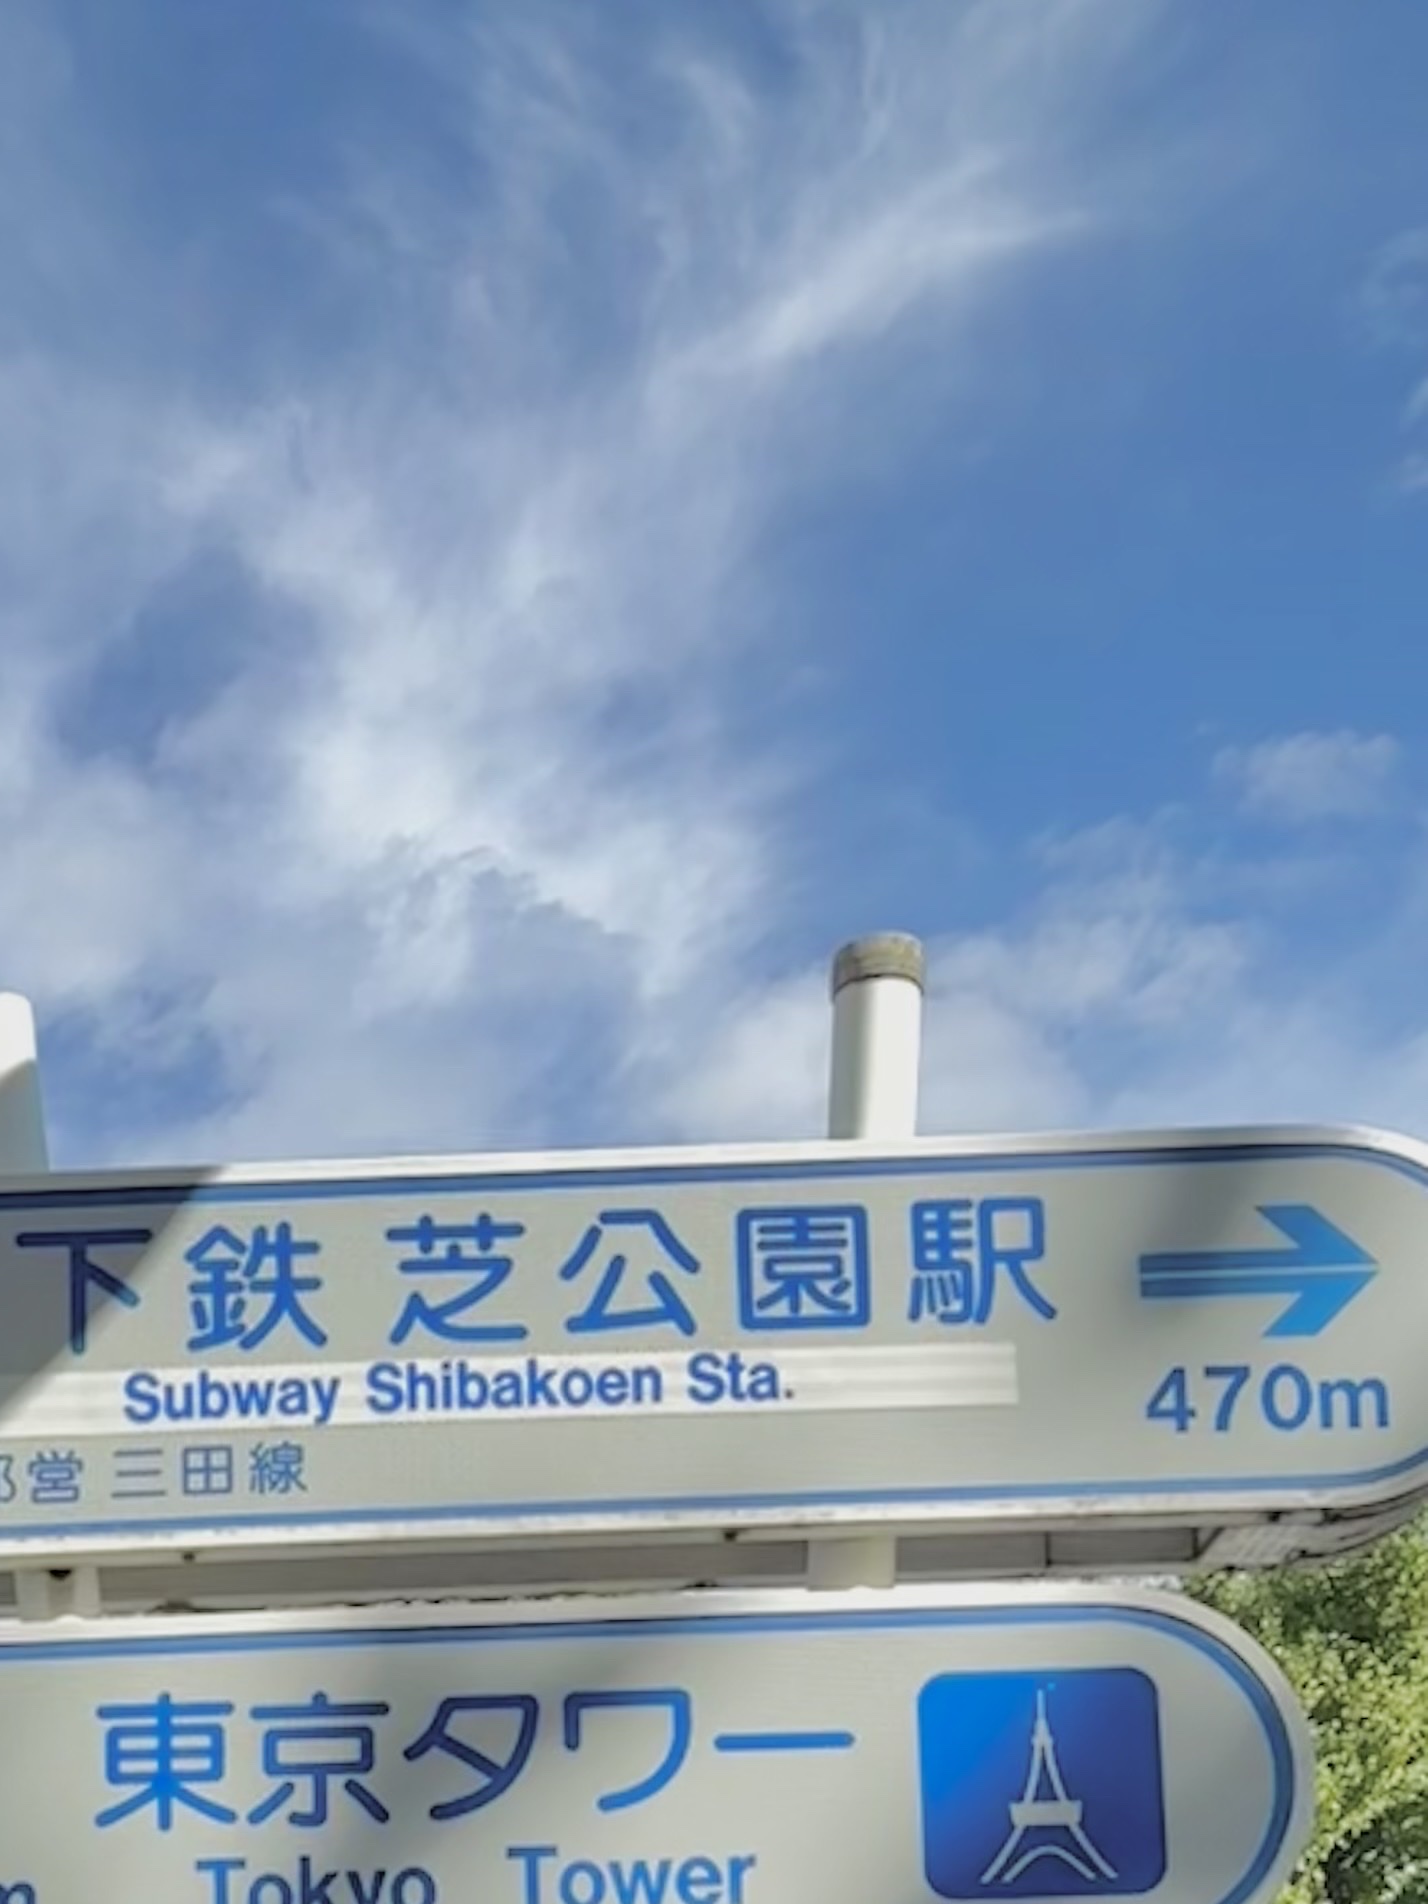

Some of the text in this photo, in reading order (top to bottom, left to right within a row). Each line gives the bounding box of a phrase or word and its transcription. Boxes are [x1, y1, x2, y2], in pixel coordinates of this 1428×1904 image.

[123, 1351, 796, 1423] Subway Shibakoen Sta.
[1146, 1364, 1390, 1432] 470m
[93, 1688, 855, 1831] 東京タワー
